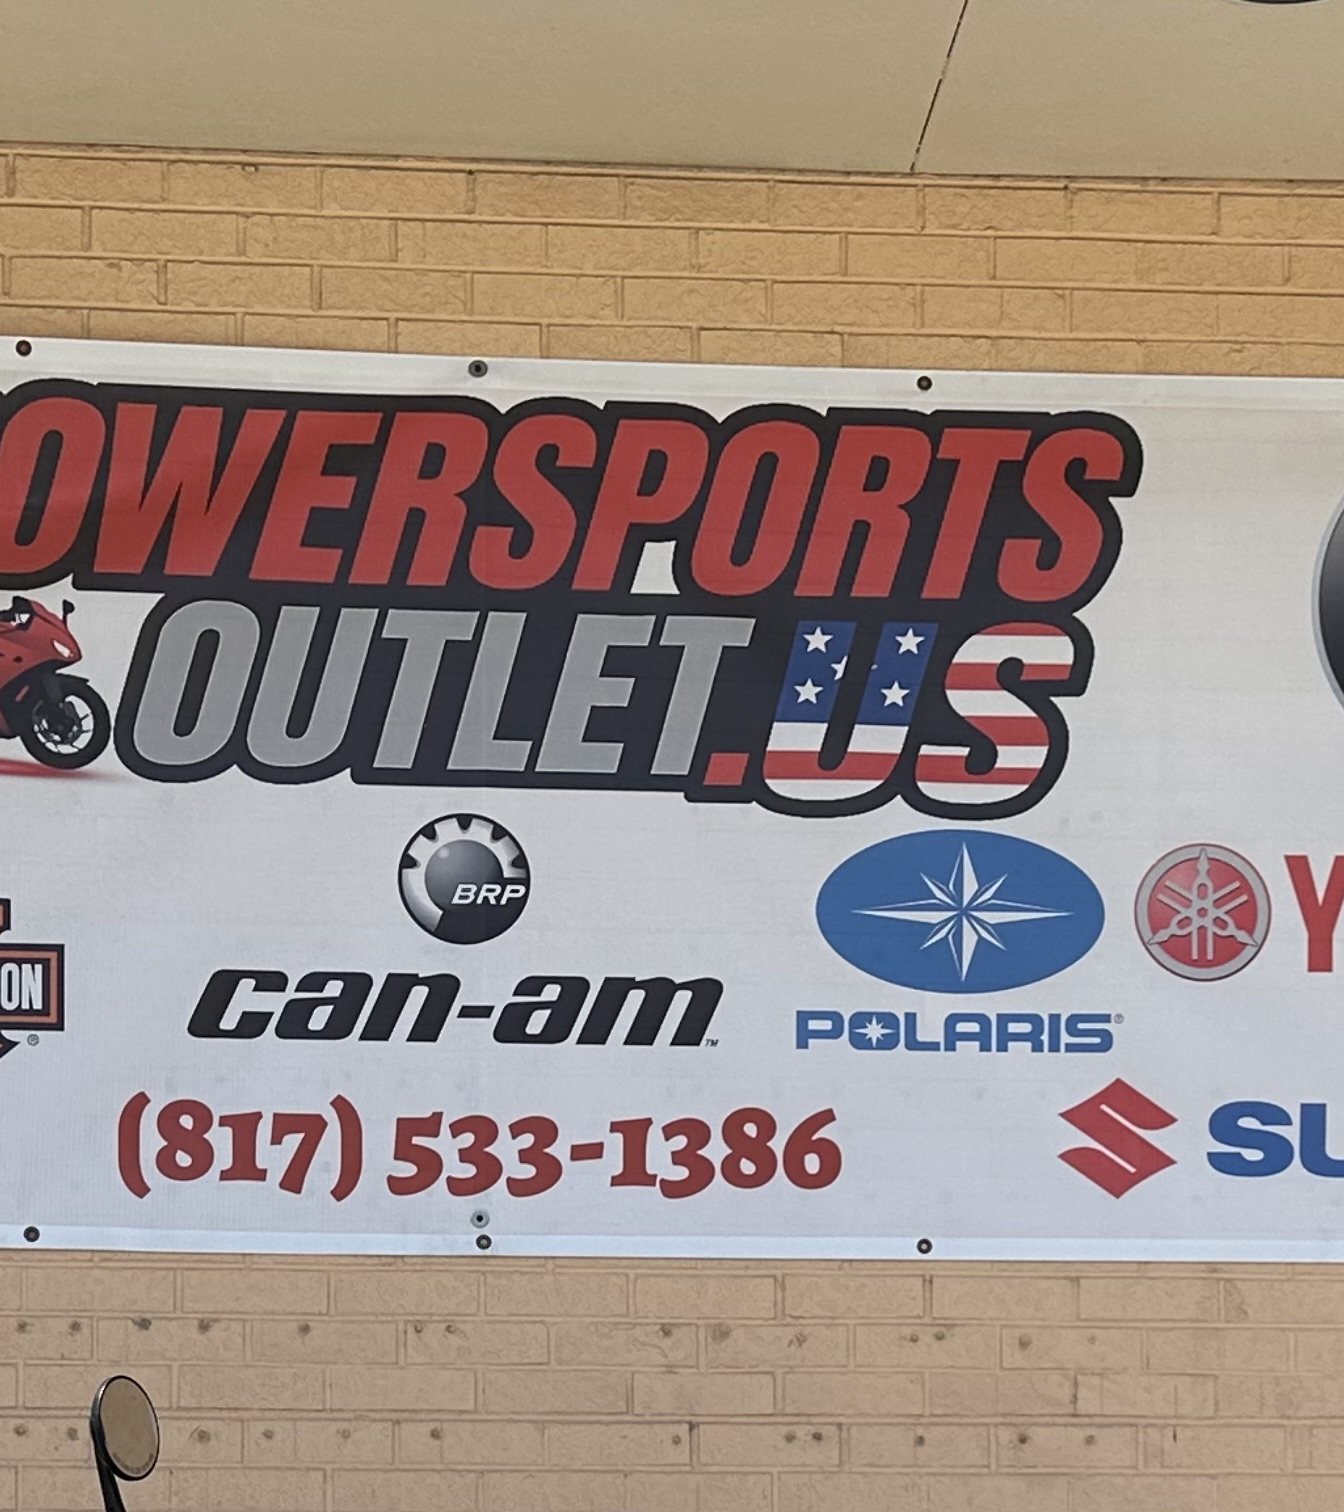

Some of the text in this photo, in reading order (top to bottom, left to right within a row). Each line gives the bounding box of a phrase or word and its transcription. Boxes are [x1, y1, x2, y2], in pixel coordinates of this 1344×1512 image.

[129, 597, 1078, 808] OUTLET.US
[452, 883, 526, 906] BRP
[795, 1009, 1115, 1054] POLARIS
[117, 1091, 843, 1202] (817) 533-1386
